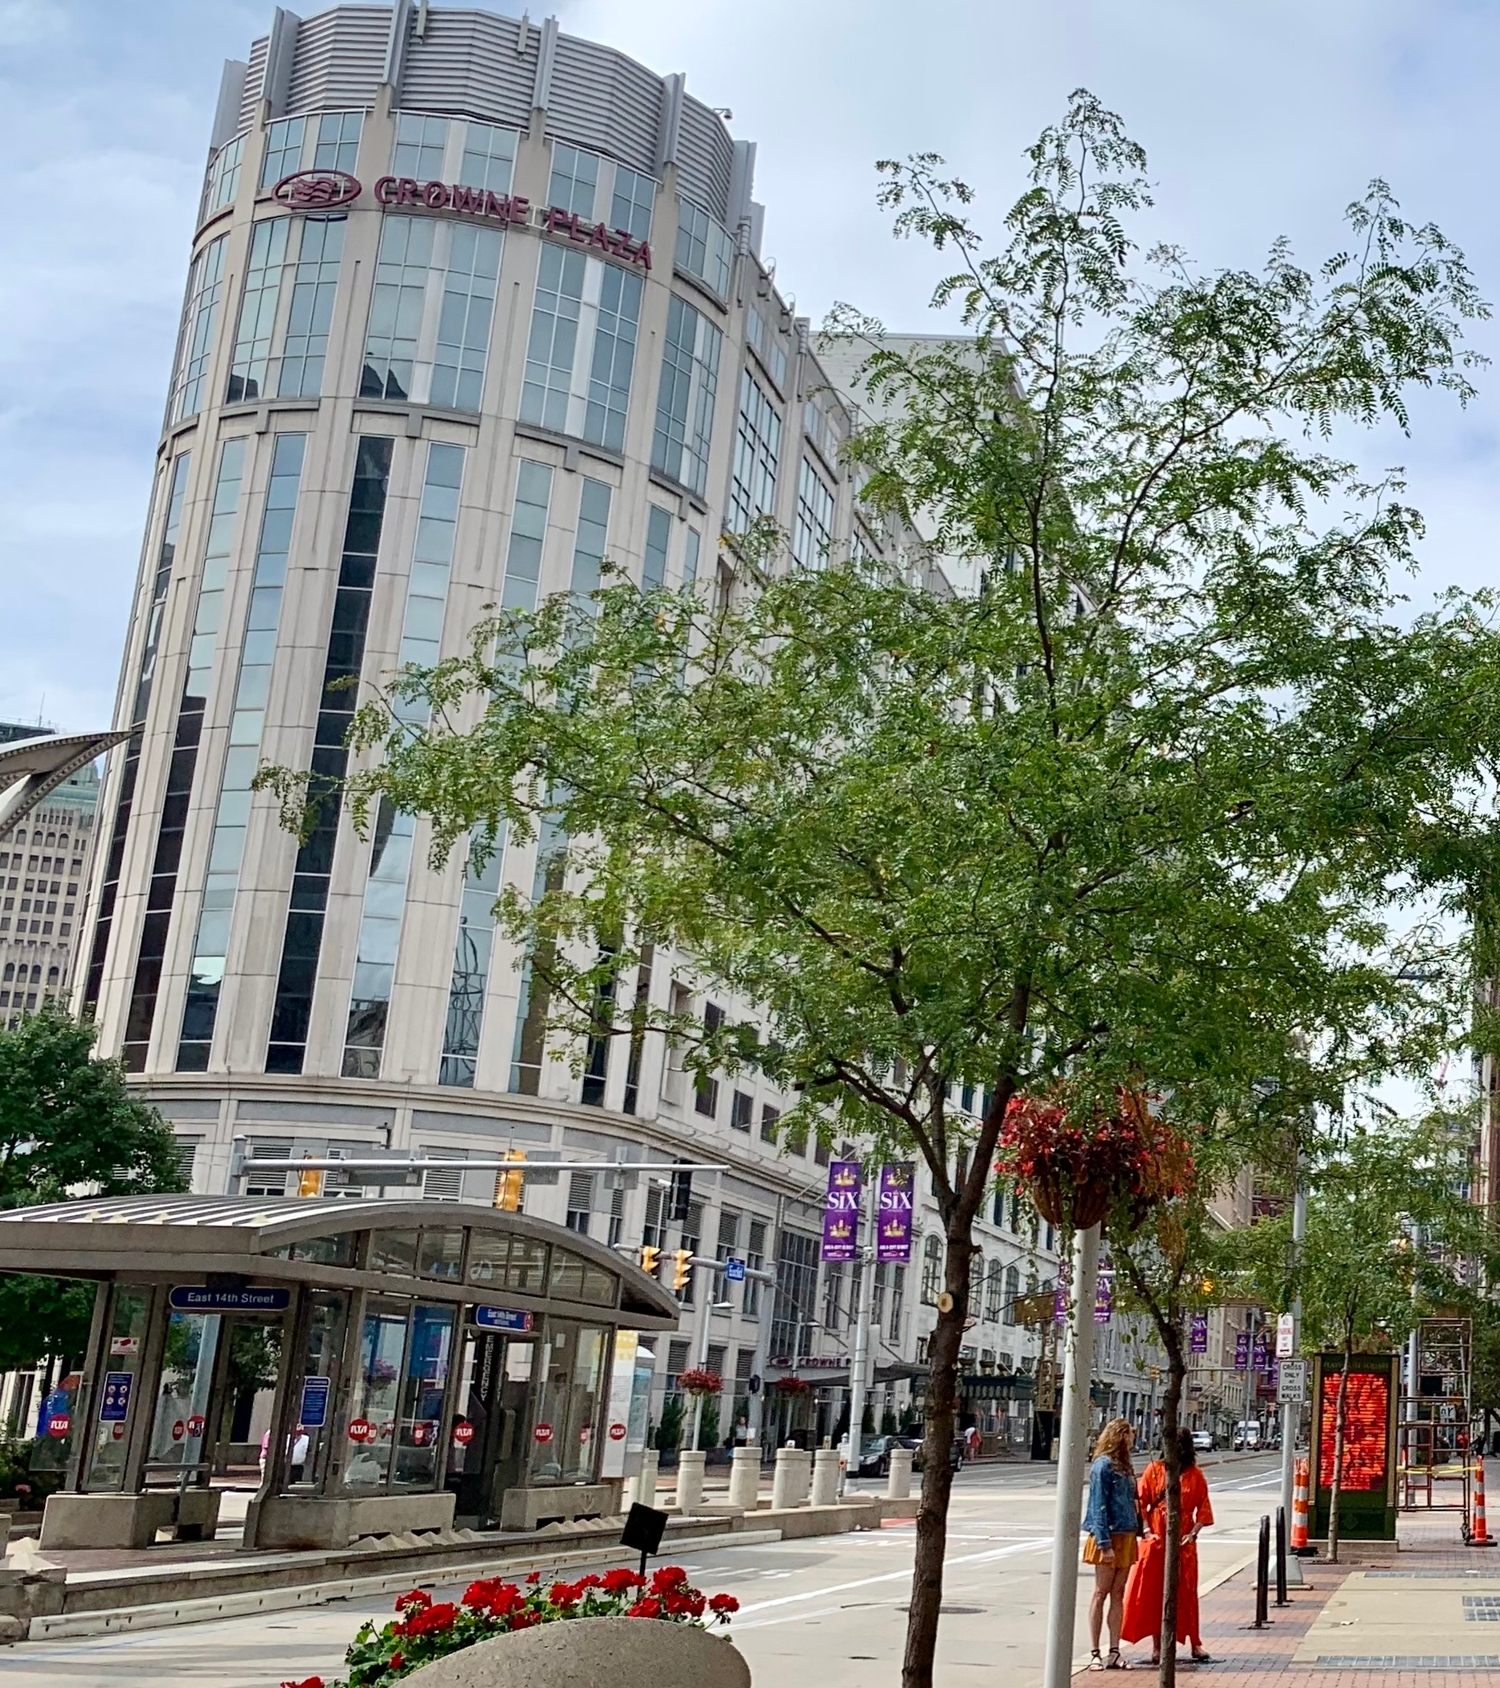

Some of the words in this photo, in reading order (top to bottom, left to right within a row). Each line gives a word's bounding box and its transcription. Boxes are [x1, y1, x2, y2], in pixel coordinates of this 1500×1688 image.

[374, 175, 531, 225] CROWNE
[545, 205, 653, 270] PLAZA
[187, 1292, 212, 1302] East
[215, 1293, 239, 1303] 14th
[241, 1293, 275, 1304] Street
[799, 1357, 842, 1368] CROWNE
